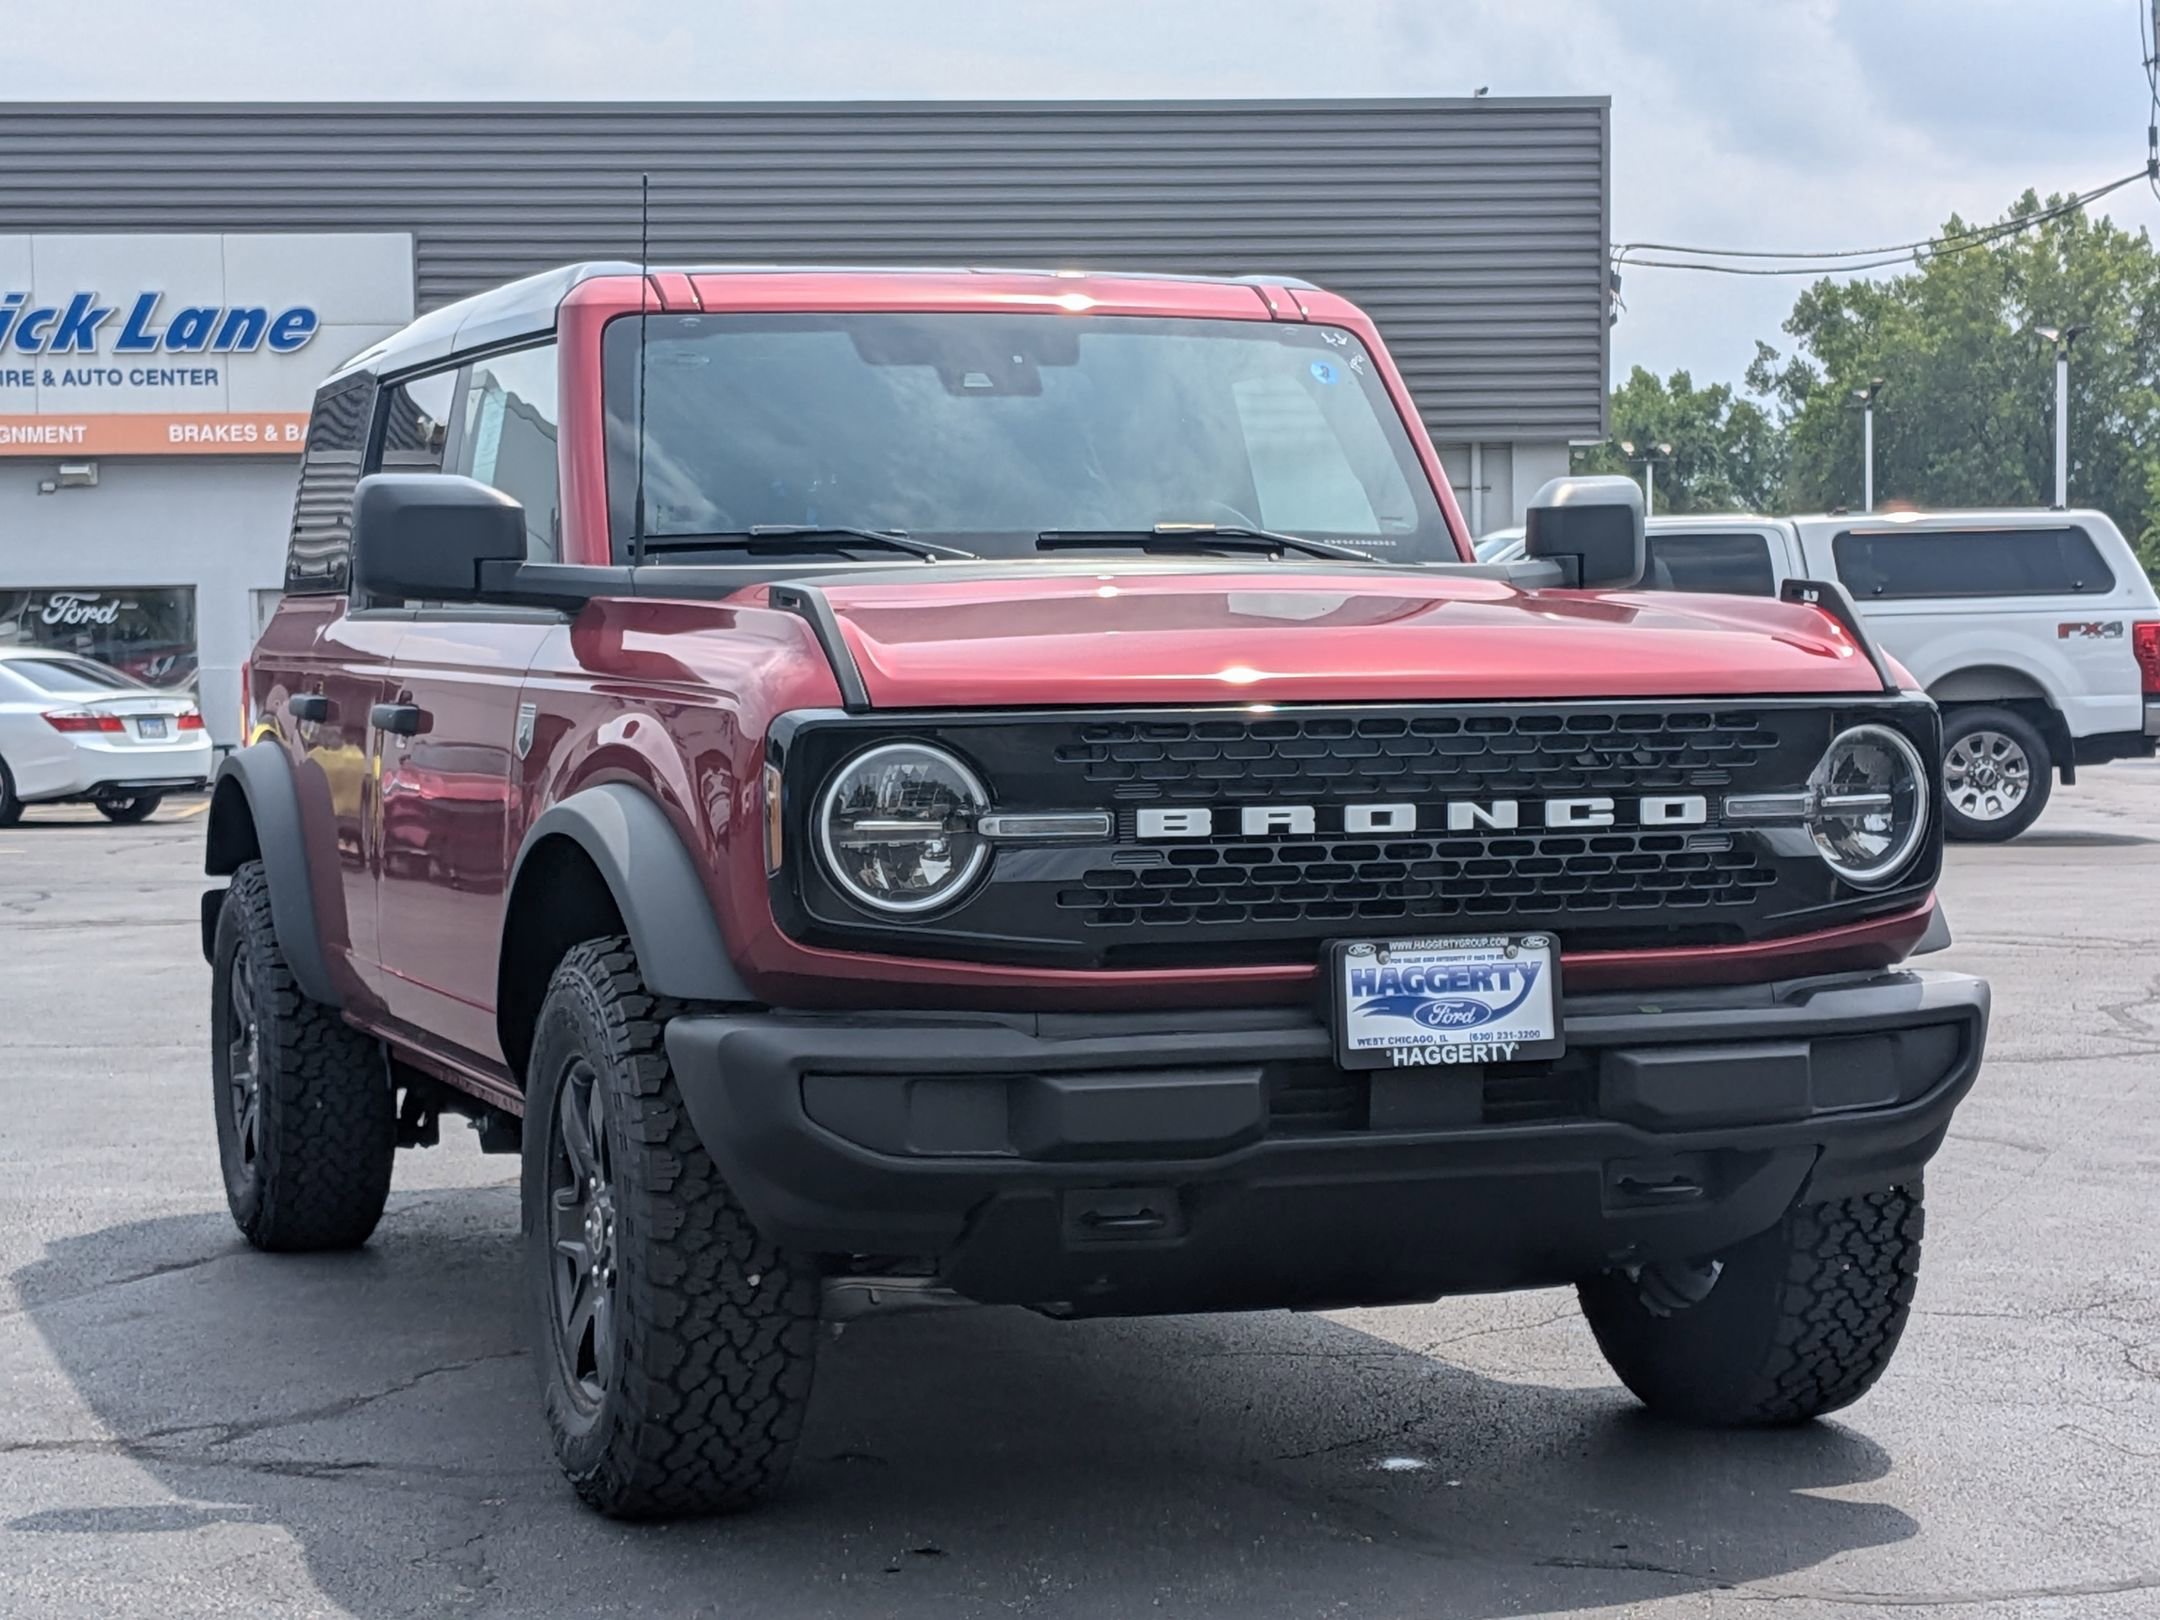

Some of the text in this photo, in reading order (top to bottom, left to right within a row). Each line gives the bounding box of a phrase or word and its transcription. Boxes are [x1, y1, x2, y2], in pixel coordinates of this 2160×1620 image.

[112, 290, 320, 354] Lane
[42, 369, 55, 387] &
[62, 369, 122, 386] AUTO
[129, 368, 219, 386] CENTER
[169, 424, 257, 442] BRAKES
[264, 424, 278, 442] &
[42, 593, 120, 624] Ford
[2058, 621, 2124, 639] FX4
[1136, 795, 1708, 839] BRONCO
[1351, 961, 1543, 997] HAGGERTY
[1428, 1002, 1476, 1025] Ford
[1357, 1037, 1385, 1046] WEST
[1393, 1042, 1516, 1067] HAGGERTY
